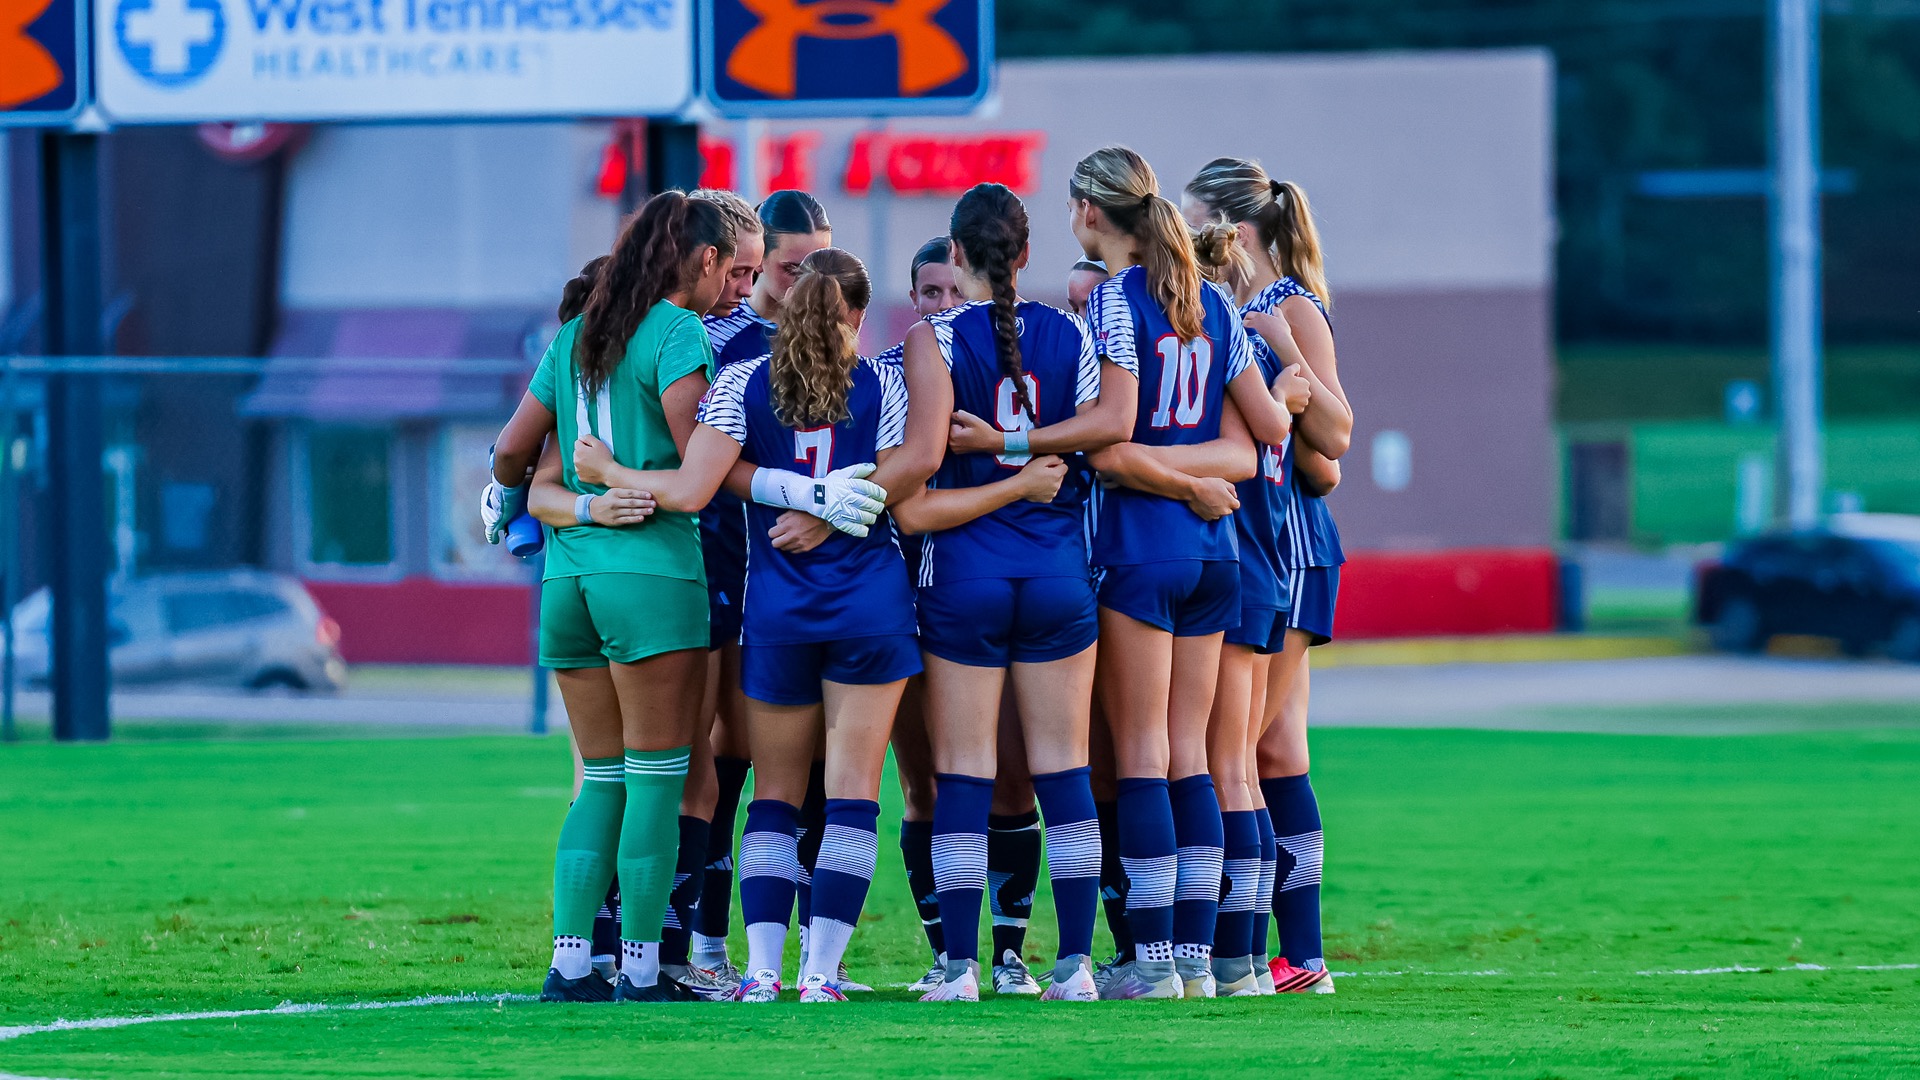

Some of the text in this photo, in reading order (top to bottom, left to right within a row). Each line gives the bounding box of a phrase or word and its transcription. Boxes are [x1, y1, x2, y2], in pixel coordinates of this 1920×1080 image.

[248, 0, 386, 34] West
[252, 44, 523, 80] HEALTHCARE
[1150, 333, 1214, 429] 10
[994, 371, 1041, 470] 9
[795, 424, 835, 479] 7
